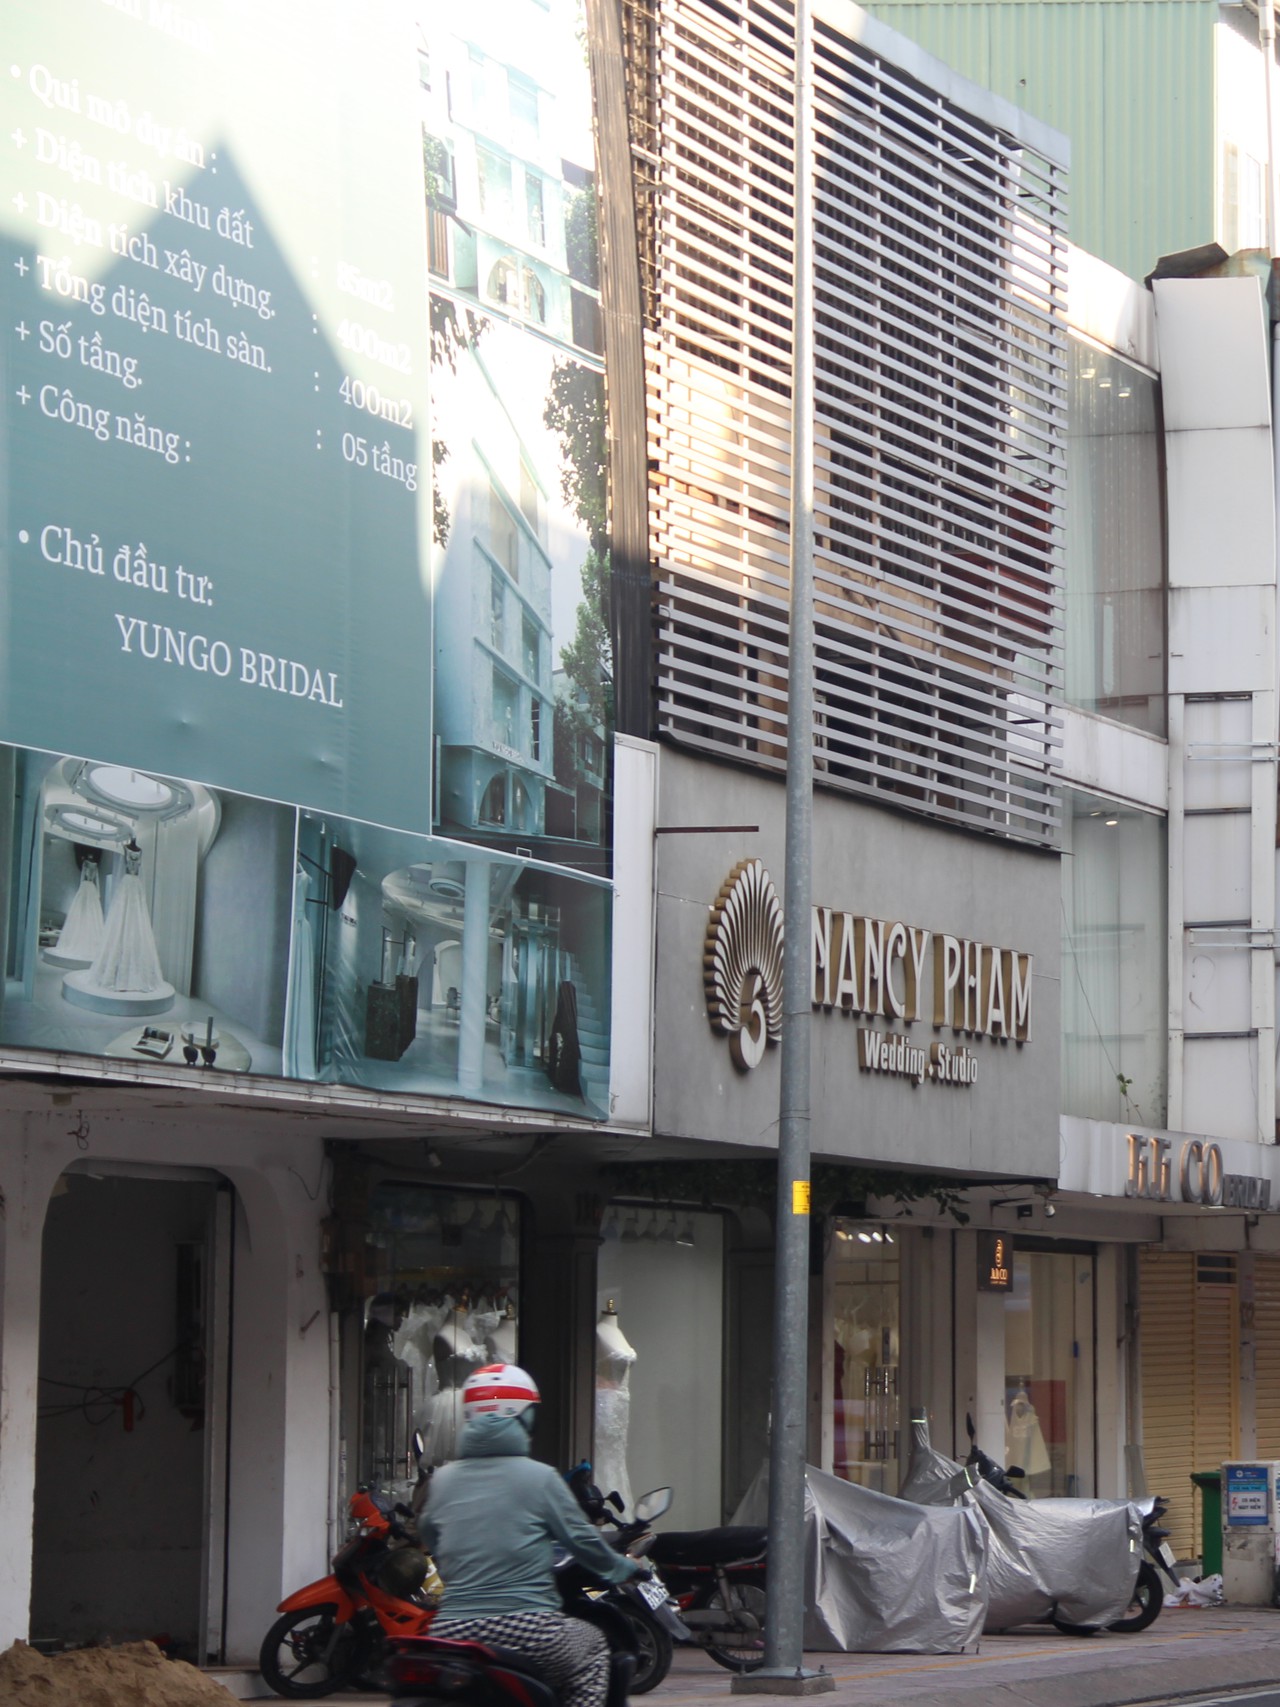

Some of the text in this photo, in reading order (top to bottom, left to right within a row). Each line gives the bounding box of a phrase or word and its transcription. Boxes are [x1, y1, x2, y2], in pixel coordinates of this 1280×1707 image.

[29, 64, 81, 112] Qui
[86, 94, 132, 134] mô
[136, 112, 173, 159] dự
[35, 127, 254, 249] Diện tích khu đất
[36, 191, 276, 320] Diện tích xây dựng.
[37, 254, 106, 316] Tổng
[112, 285, 168, 333] diện
[174, 310, 222, 353] tích
[39, 320, 142, 389] Số tầng.
[337, 318, 412, 375] 400m2
[39, 384, 110, 441] Công
[339, 375, 413, 430] 400m2
[342, 432, 418, 491] 05 tầng
[40, 523, 214, 606] Chủ đầu tư:
[115, 614, 343, 709] YUNGO BRIDAL
[811, 905, 1034, 1043] NANCY PHAM
[859, 1028, 978, 1084] Wedding Studio
